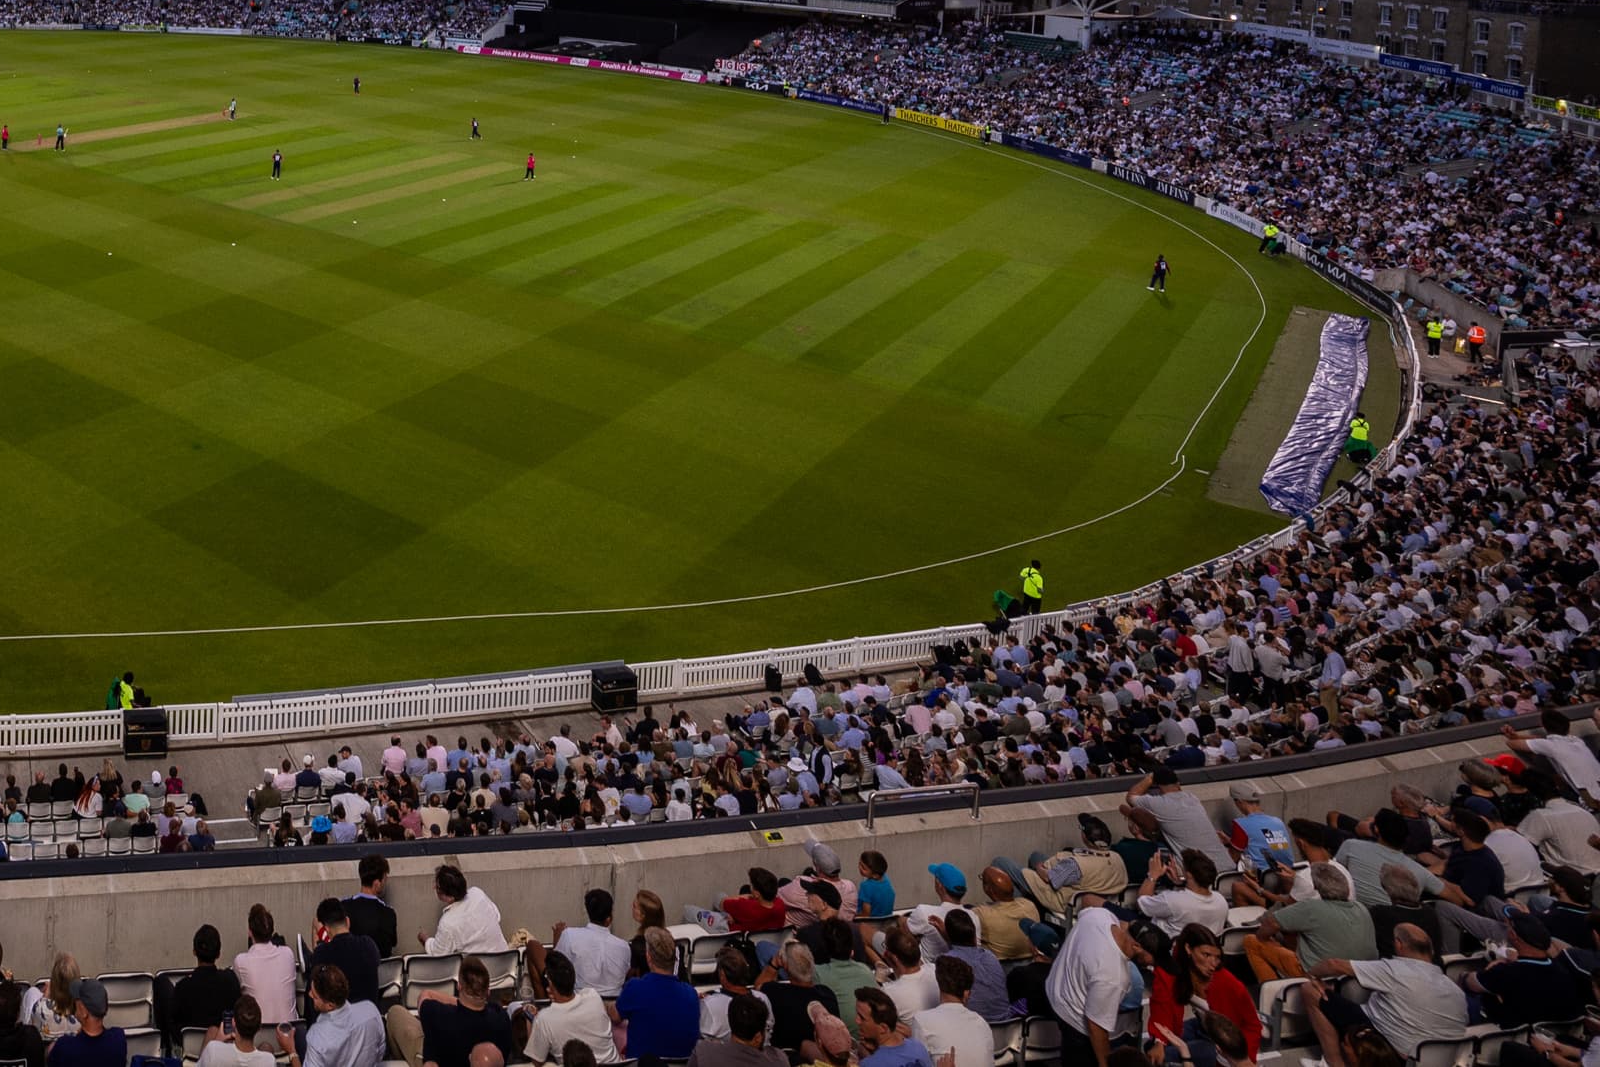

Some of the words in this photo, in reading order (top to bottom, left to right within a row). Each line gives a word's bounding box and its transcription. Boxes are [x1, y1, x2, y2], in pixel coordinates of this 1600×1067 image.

[492, 49, 512, 57] Health
[530, 53, 558, 62] Insurance
[601, 61, 620, 70] Health
[640, 66, 669, 77] Insurance
[737, 62, 746, 71] IG
[900, 110, 938, 127] THATCHERS
[944, 120, 982, 136] THATCHERS
[1112, 167, 1125, 180] JM
[1157, 181, 1170, 196] JM
[1169, 186, 1189, 202] FINN
